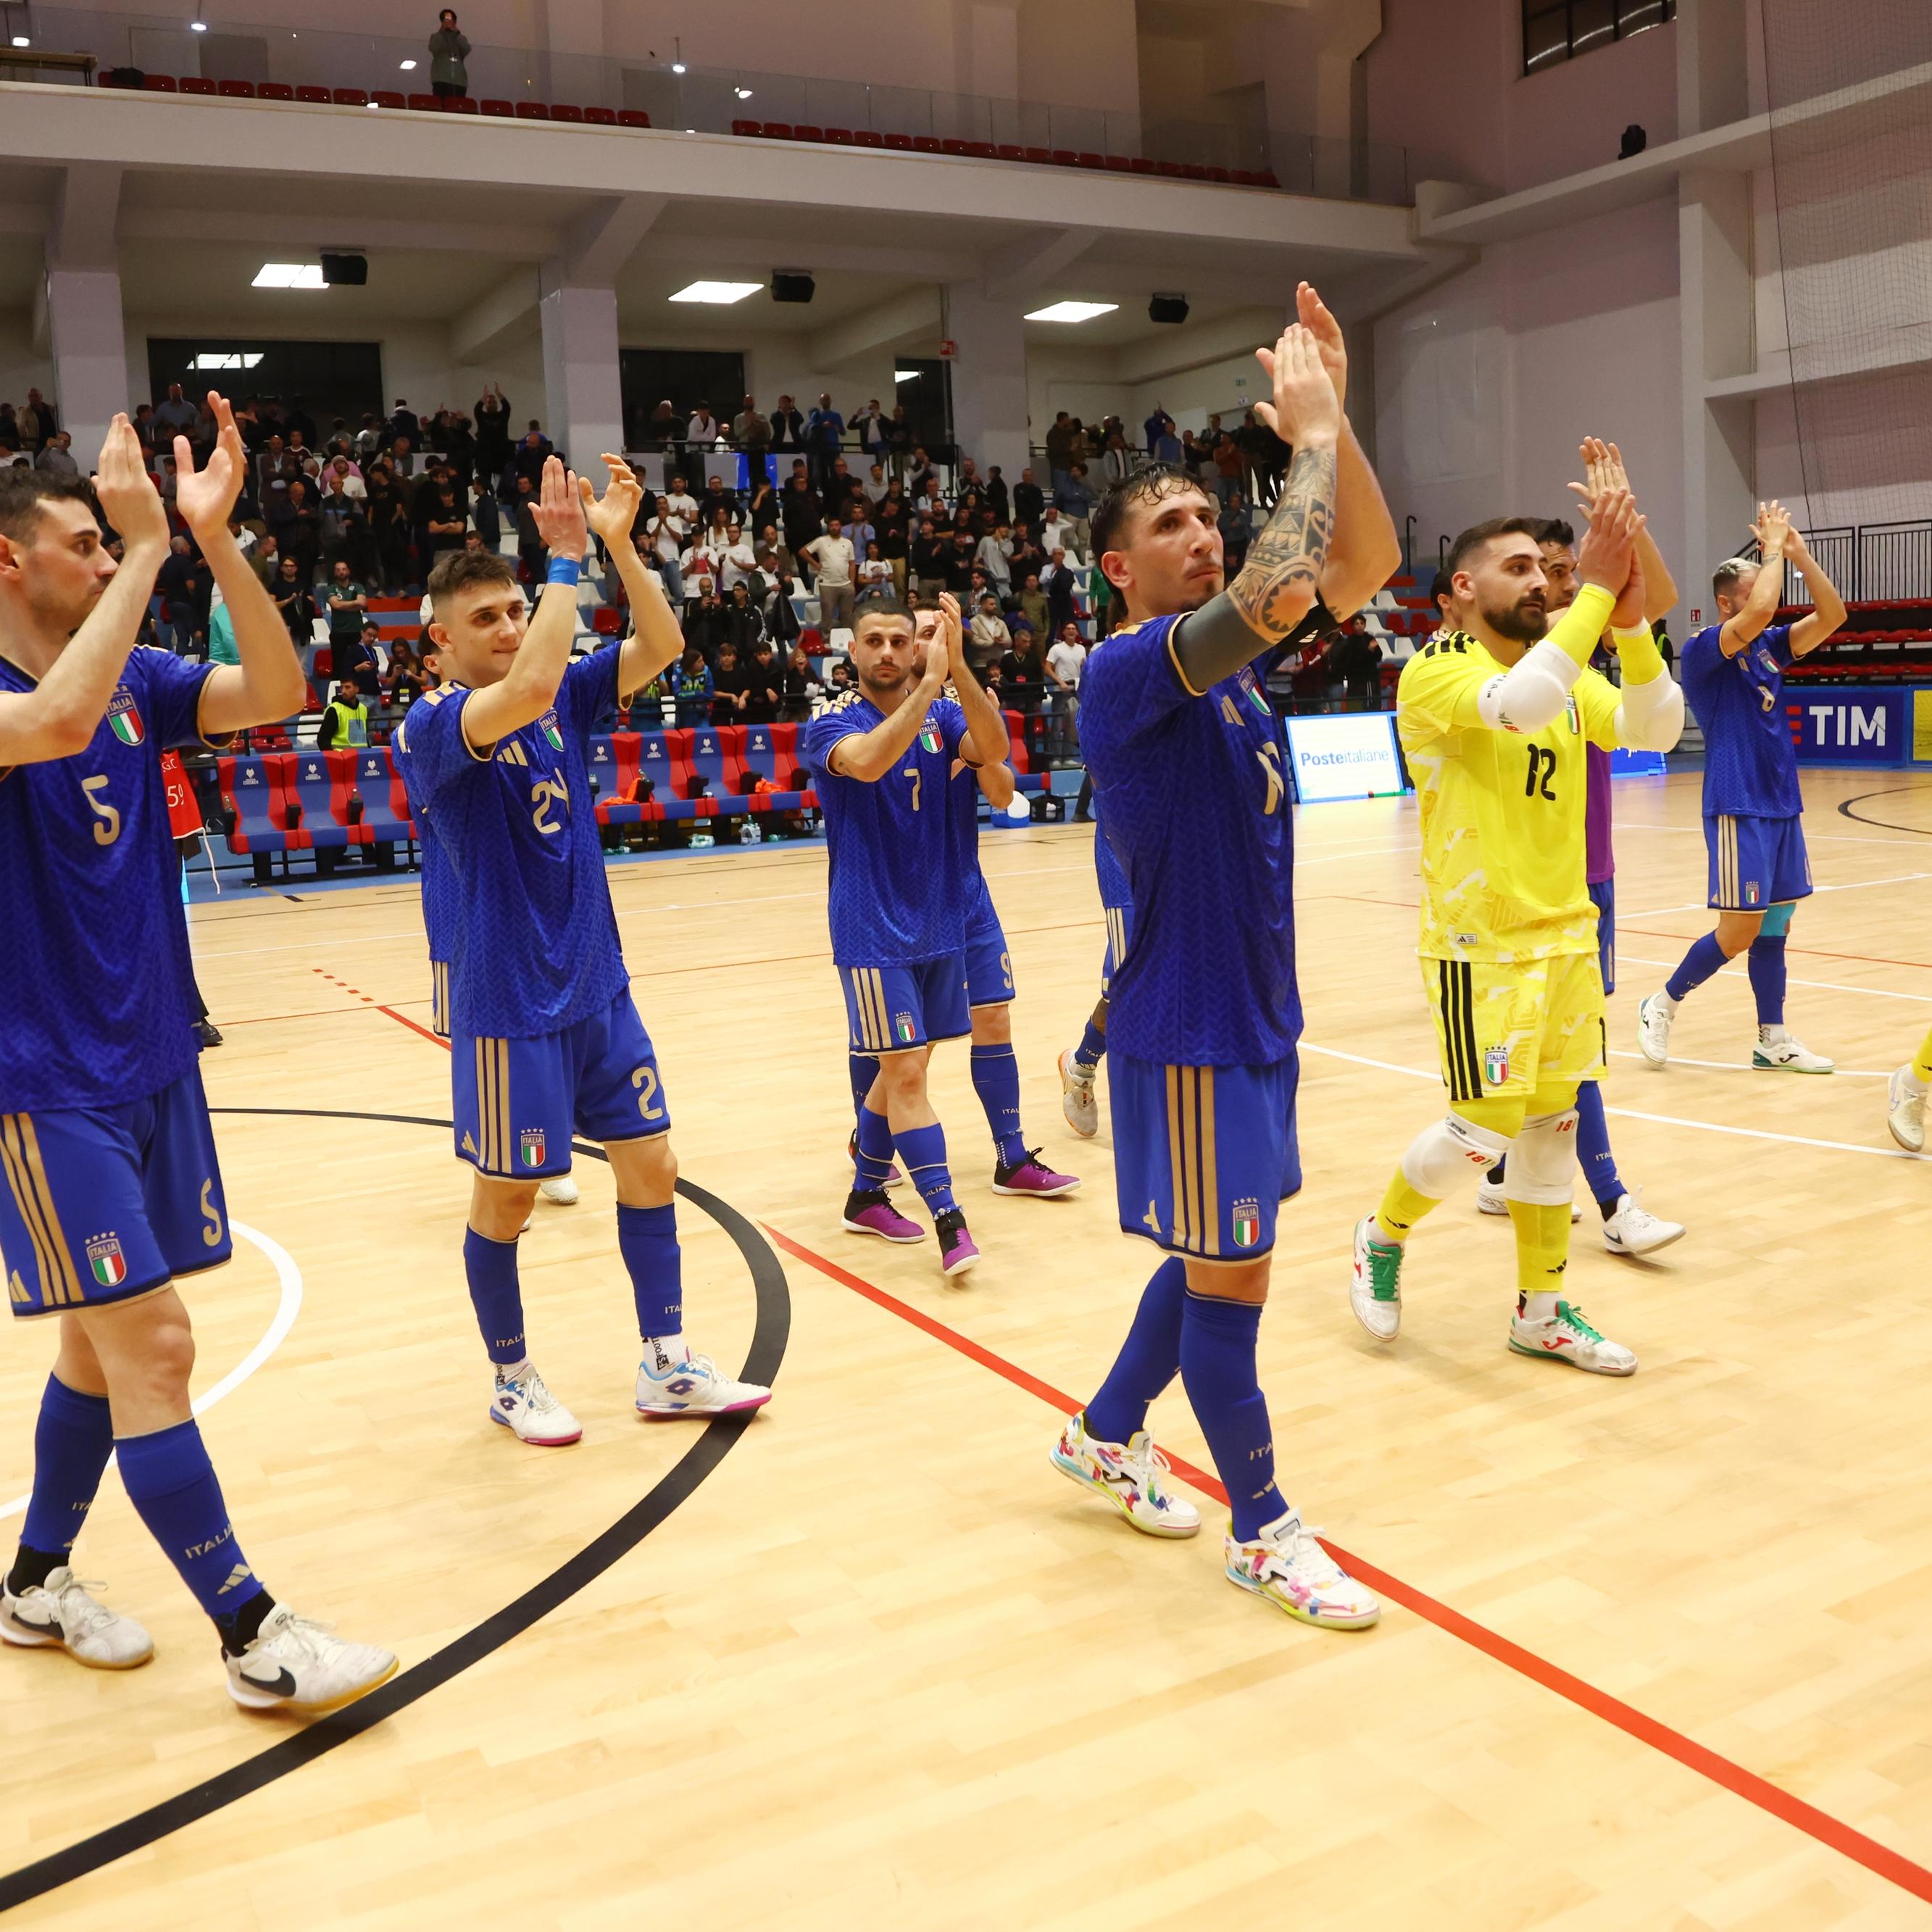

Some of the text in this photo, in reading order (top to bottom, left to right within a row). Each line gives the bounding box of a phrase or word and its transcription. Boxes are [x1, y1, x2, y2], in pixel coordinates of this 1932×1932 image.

[541, 714, 557, 728] ITALIA
[920, 724, 937, 733] ITALIA
[1809, 705, 1886, 746] TIM
[1300, 749, 1389, 766] Posteitaliane
[1525, 744, 1557, 801] 12
[531, 767, 570, 834] 24
[903, 768, 921, 812] 7
[81, 775, 120, 846] 5
[897, 1016, 912, 1025] ITALIA
[632, 1059, 664, 1120] 2
[522, 1136, 543, 1144] ITALIA
[200, 1177, 222, 1246] 5
[1234, 1207, 1257, 1219] ITALIA
[89, 1241, 117, 1258] ITALIA
